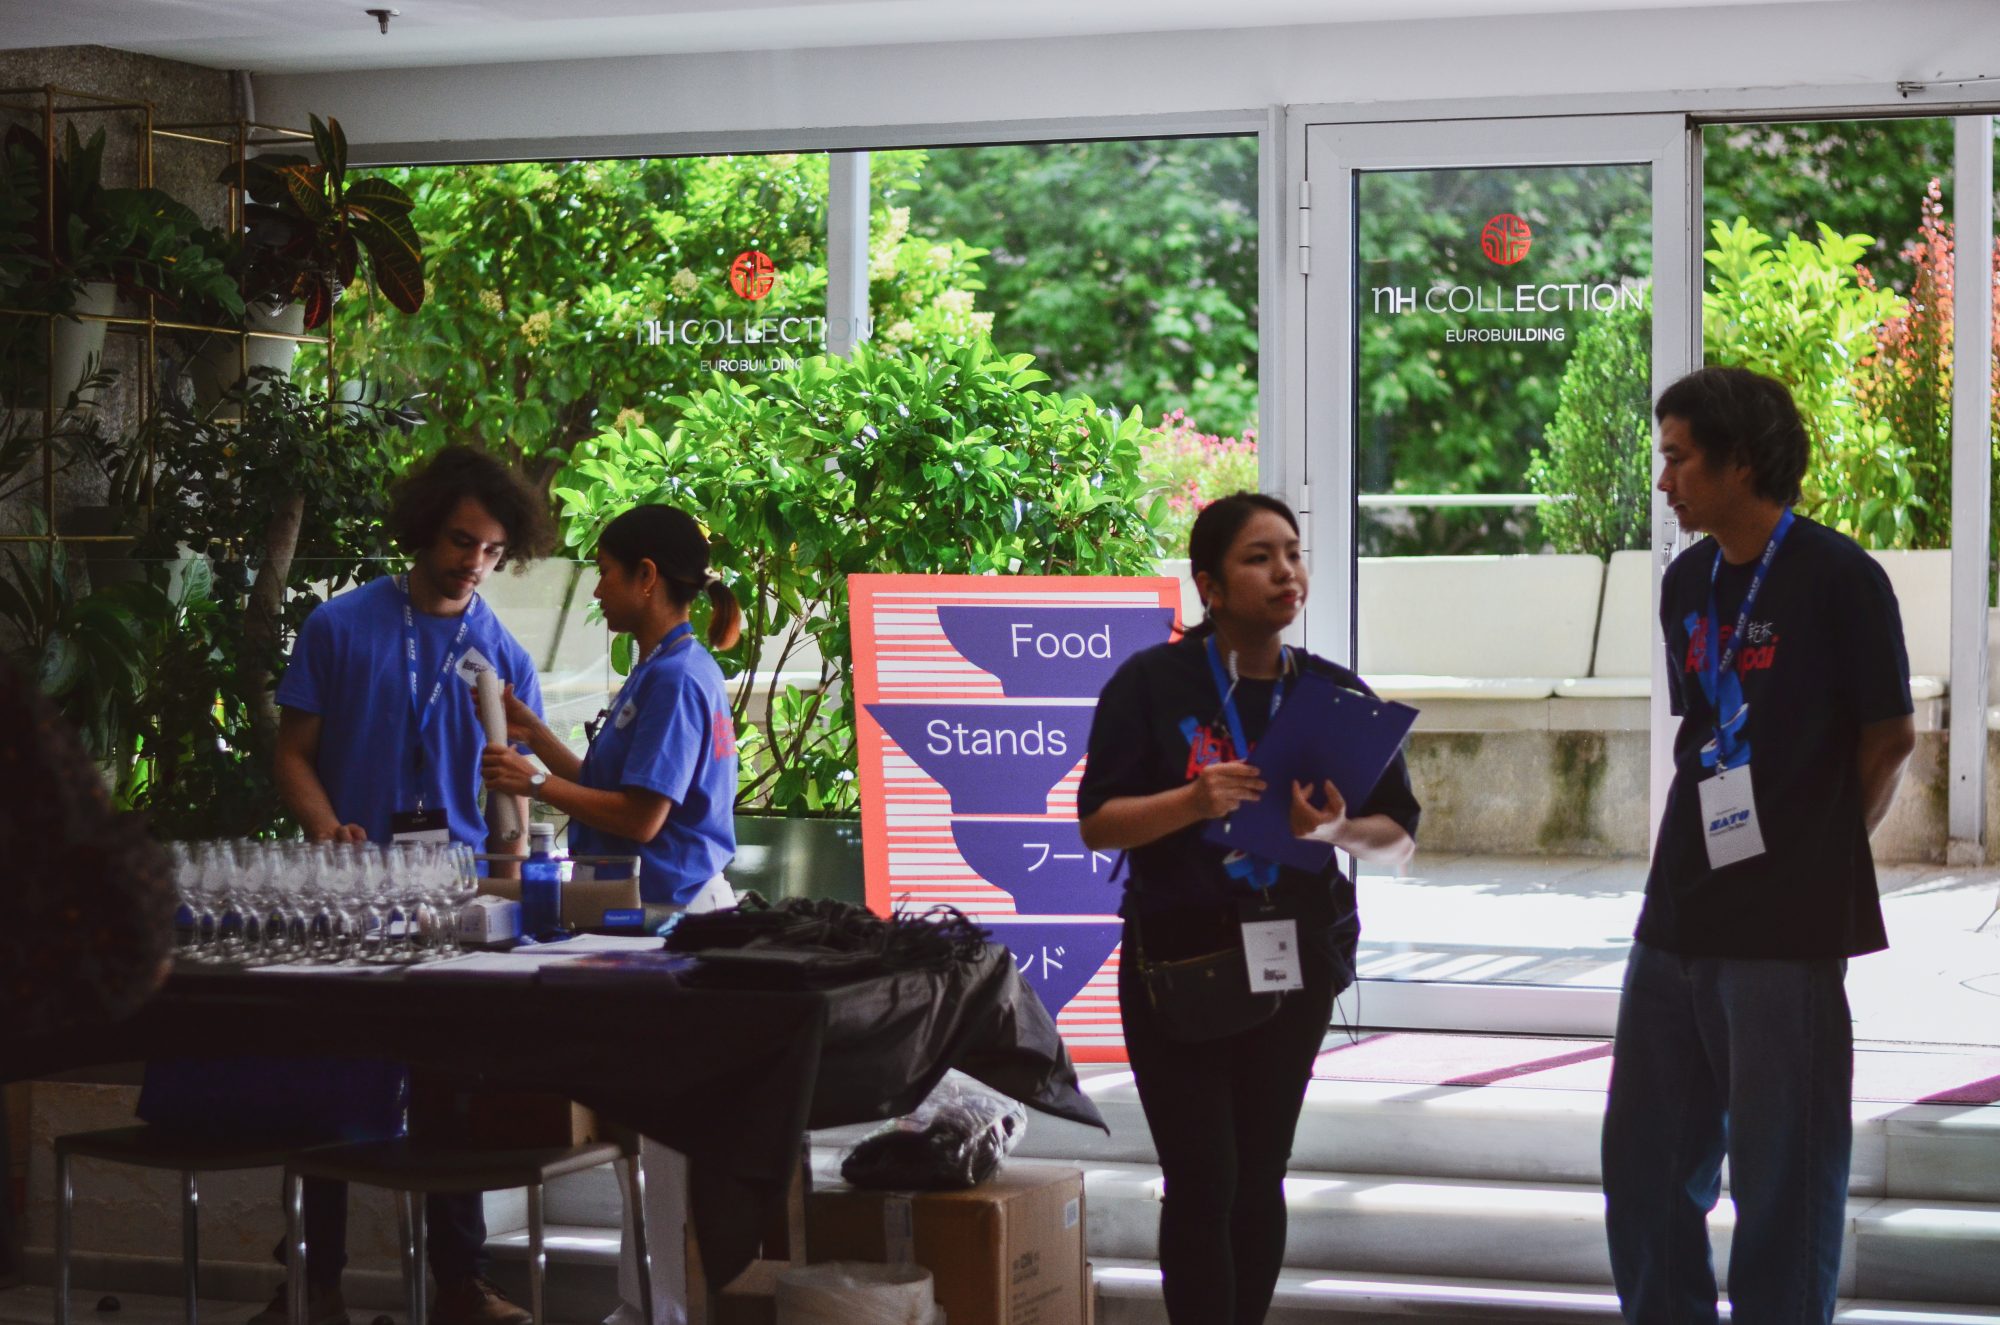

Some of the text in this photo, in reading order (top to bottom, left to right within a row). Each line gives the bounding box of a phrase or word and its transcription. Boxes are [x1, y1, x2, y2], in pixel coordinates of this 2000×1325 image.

[1425, 283, 1645, 314] COLLECTION
[680, 316, 875, 346] COLLECTION
[1445, 327, 1566, 343] EUROBUILDING
[1010, 623, 1112, 659] Food
[926, 719, 1068, 756] Stands
[1009, 945, 1066, 980] ンド
